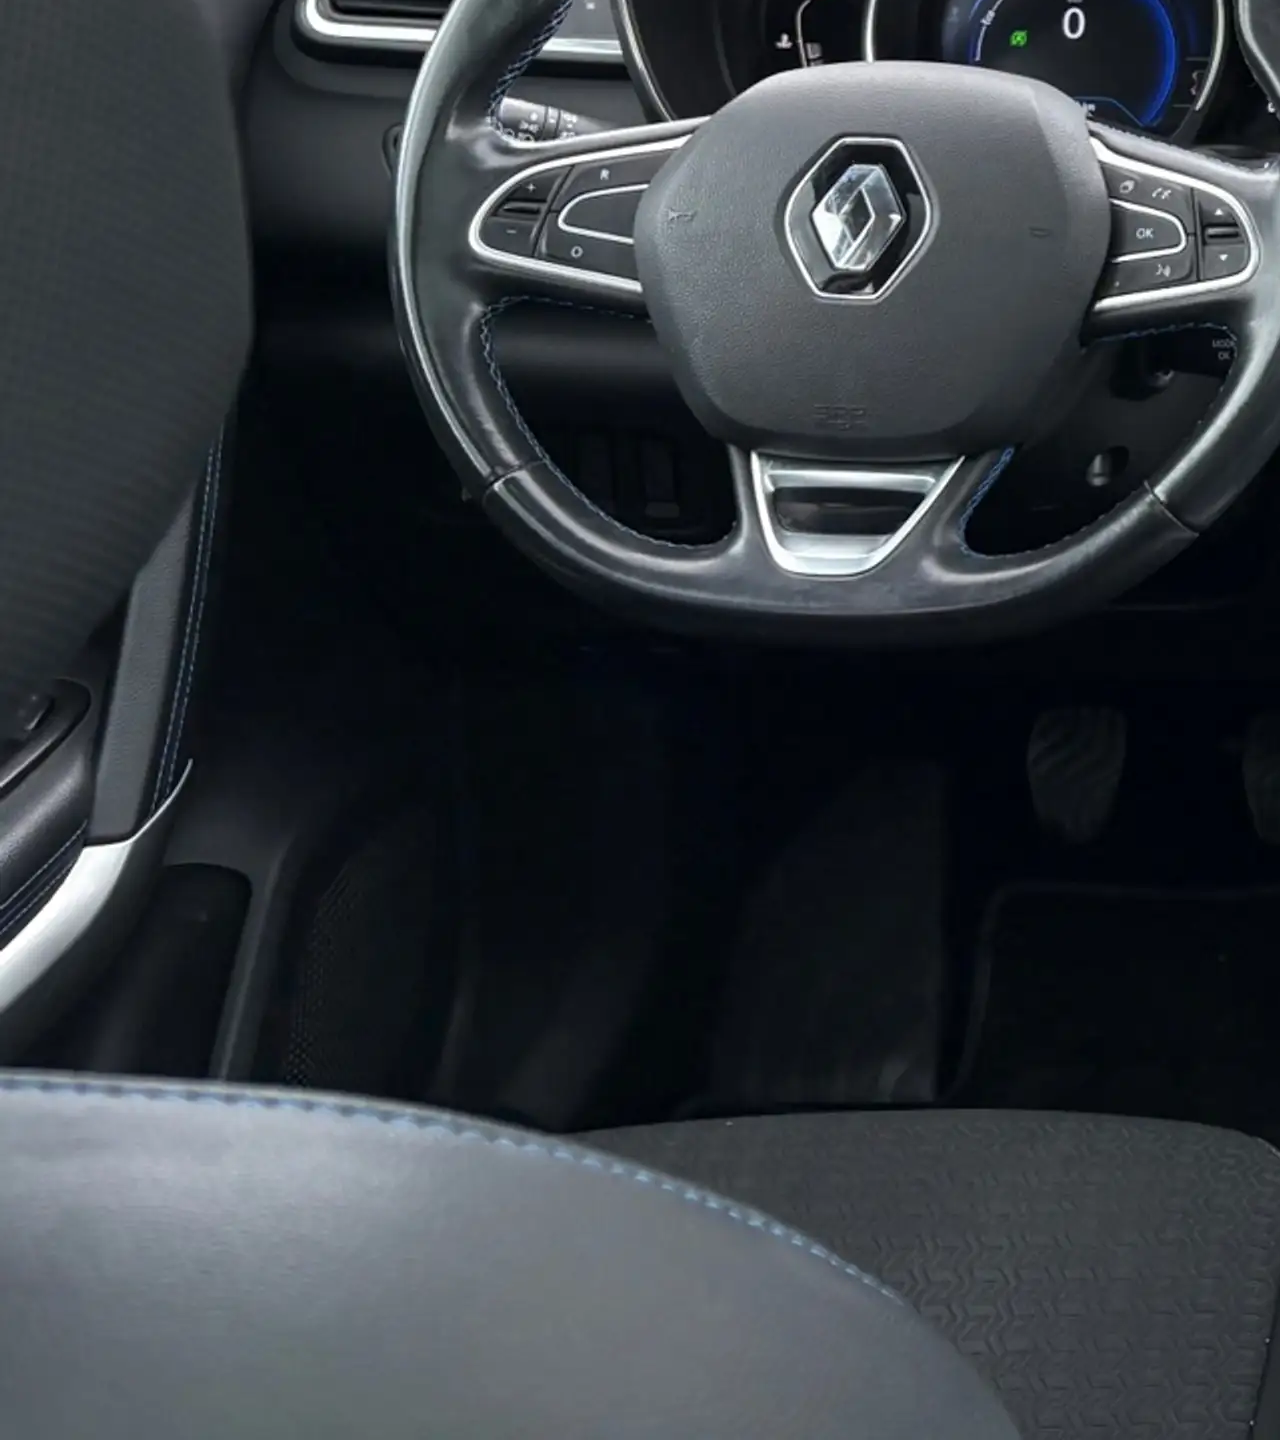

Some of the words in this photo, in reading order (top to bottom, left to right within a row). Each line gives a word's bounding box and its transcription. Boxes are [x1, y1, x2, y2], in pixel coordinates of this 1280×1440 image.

[1061, 6, 1087, 40] 0
[599, 168, 611, 181] R
[1135, 227, 1155, 240] OK
